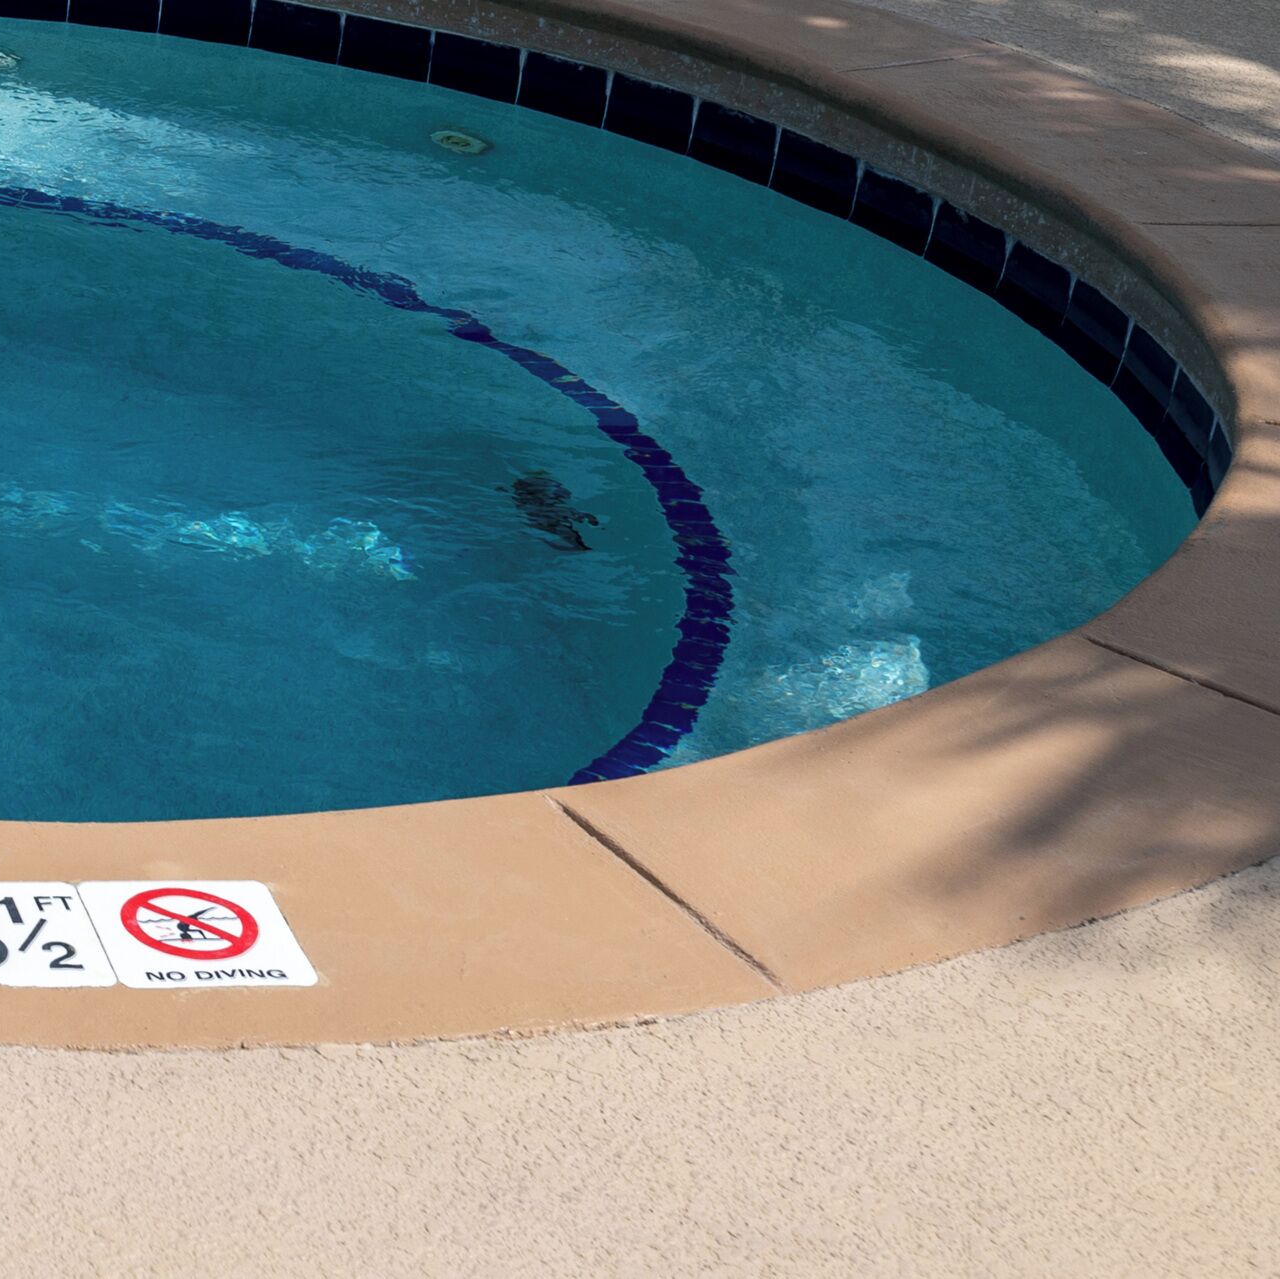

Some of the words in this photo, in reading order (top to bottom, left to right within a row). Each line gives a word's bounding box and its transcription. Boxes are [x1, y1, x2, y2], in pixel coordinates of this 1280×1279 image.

[34, 896, 72, 911] FT
[145, 971, 186, 981] NO
[194, 969, 288, 980] DIVING
